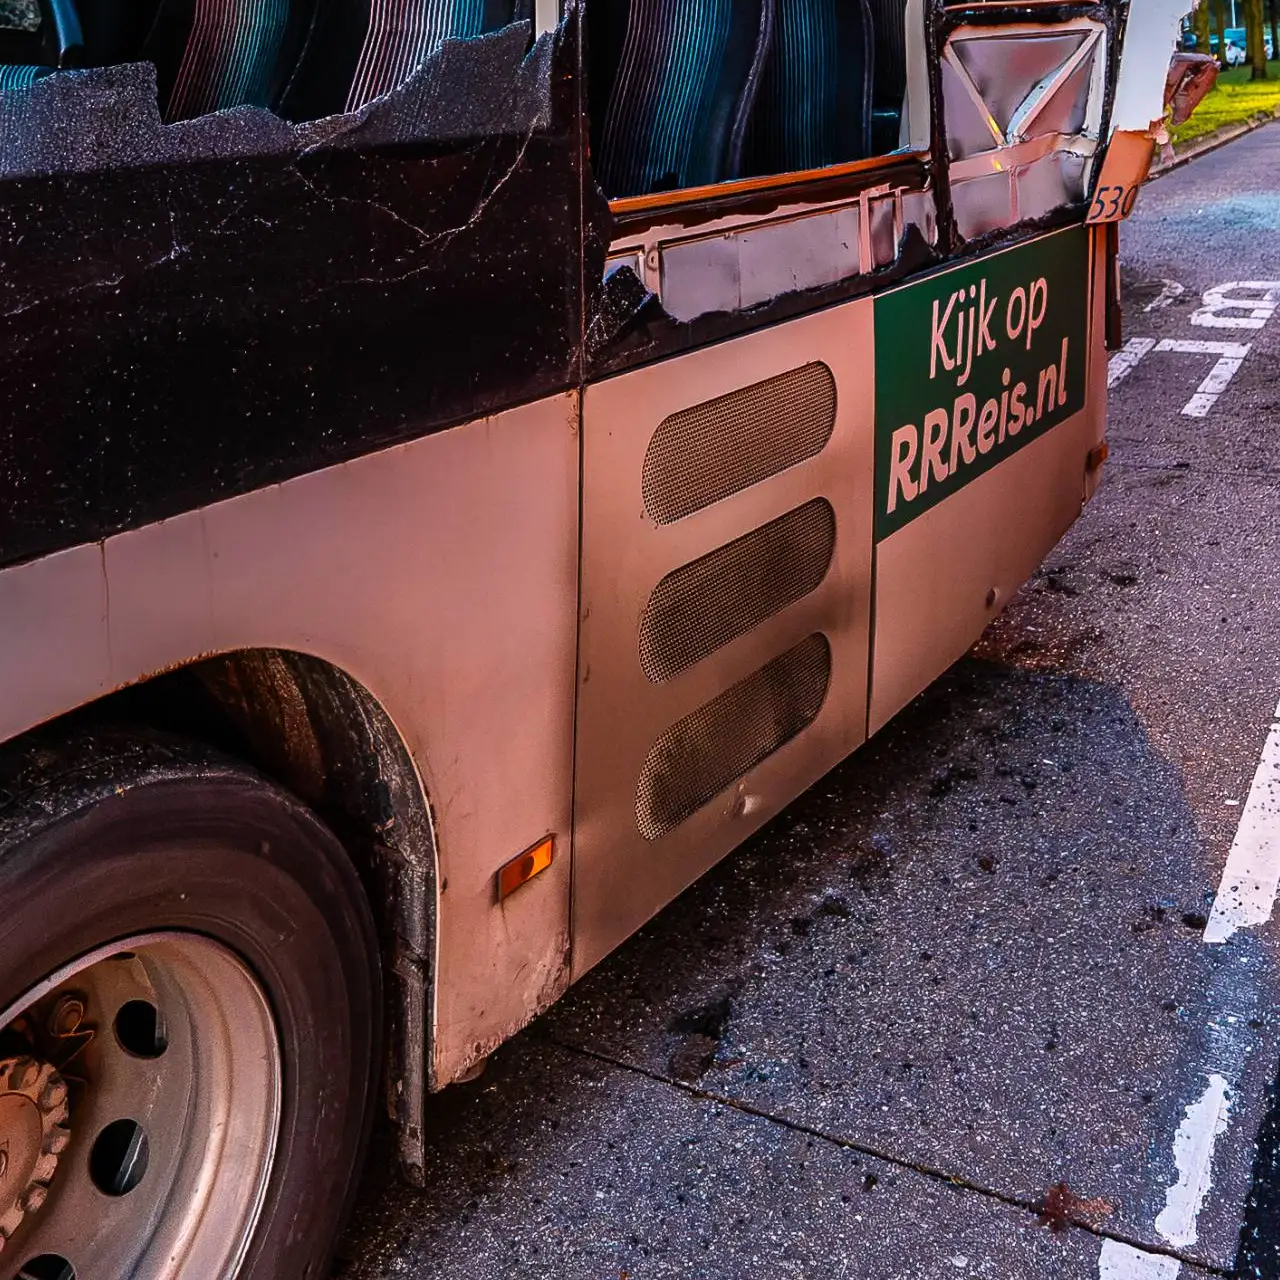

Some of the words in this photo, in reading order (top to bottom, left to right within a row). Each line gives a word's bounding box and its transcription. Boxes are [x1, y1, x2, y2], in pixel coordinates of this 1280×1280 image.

[929, 278, 996, 386] Kijk
[1006, 276, 1048, 350] op
[886, 337, 1069, 514] RRReis.nl
